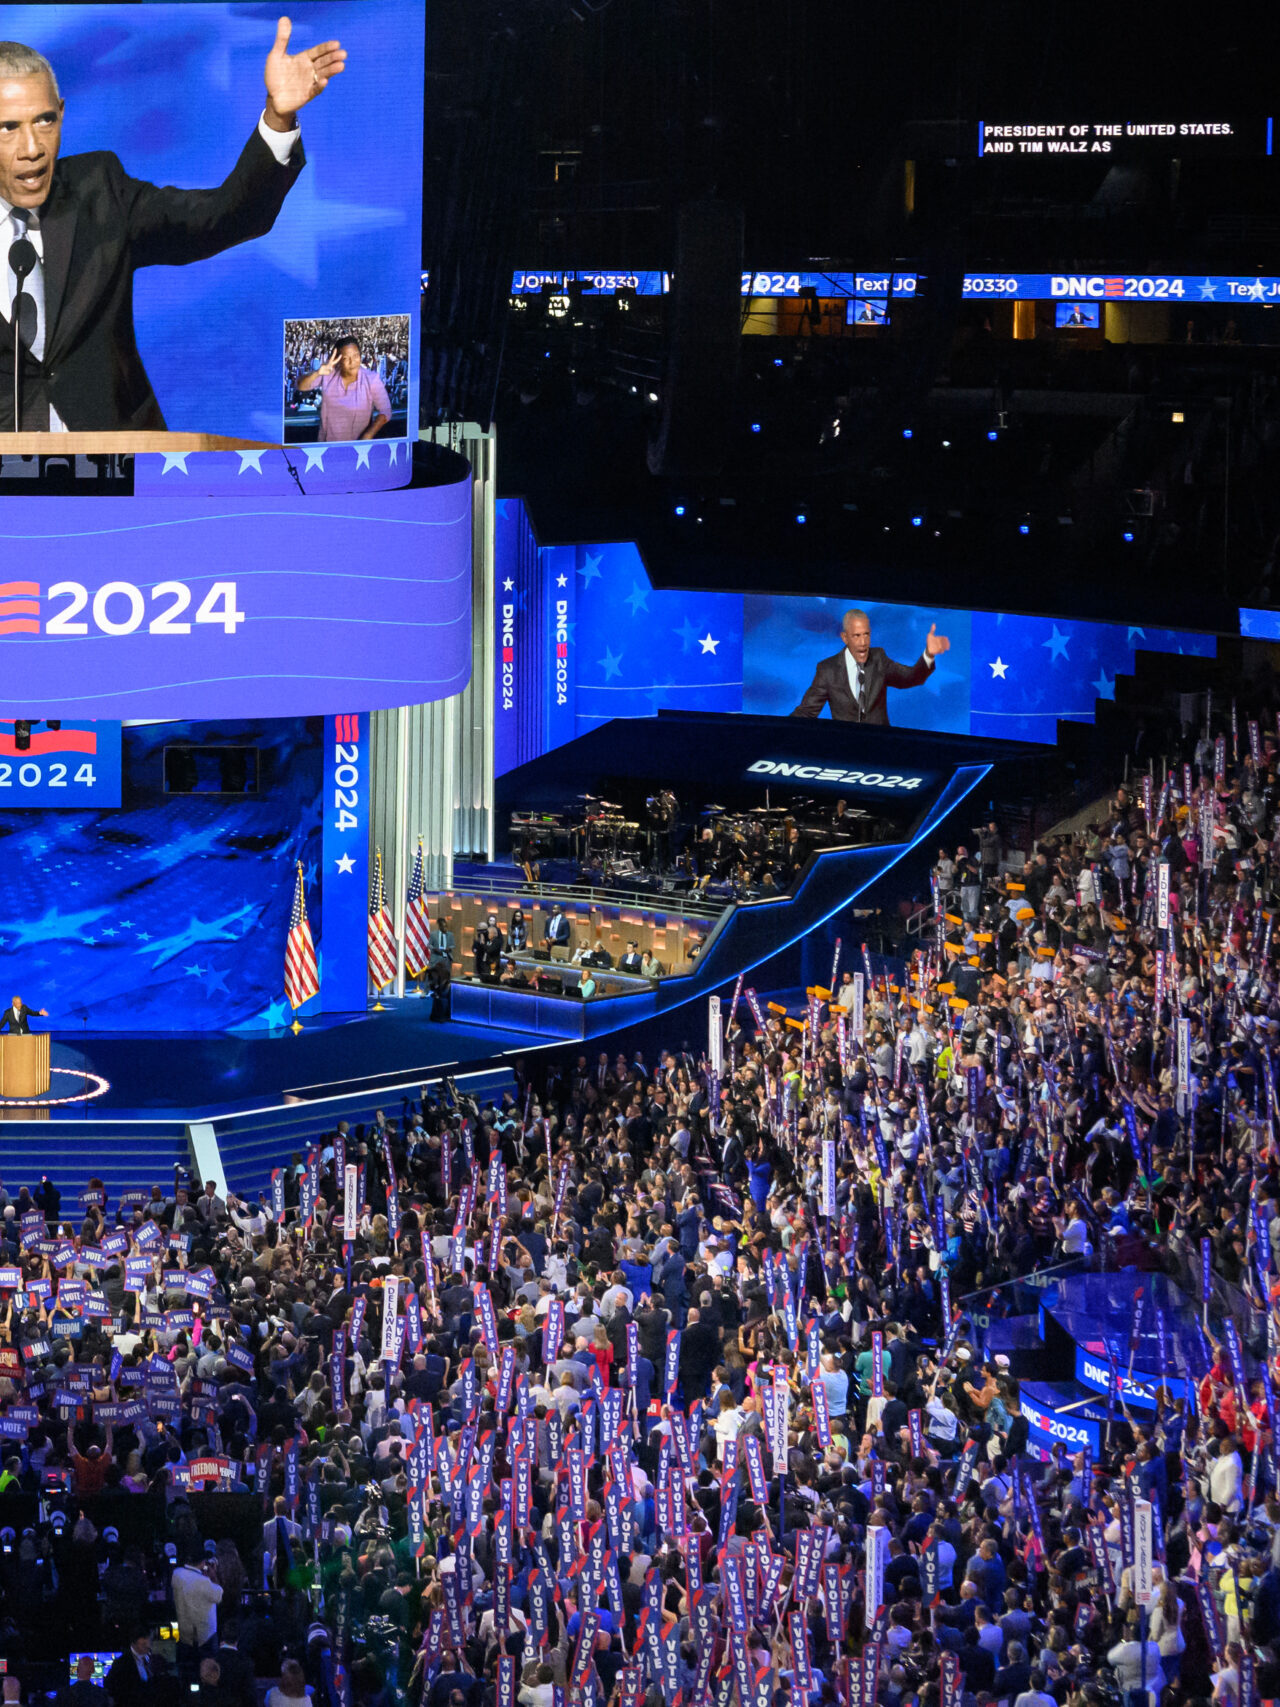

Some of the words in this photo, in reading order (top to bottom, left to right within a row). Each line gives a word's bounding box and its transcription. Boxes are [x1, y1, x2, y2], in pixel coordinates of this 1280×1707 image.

[985, 126, 1065, 137] PRESIDENT
[1070, 125, 1089, 136] OF
[1095, 124, 1122, 136] THE
[1127, 124, 1176, 135] UNITED
[1180, 123, 1234, 135] STATES.
[984, 141, 1014, 153] AND
[1019, 141, 1043, 153] TIM
[1048, 141, 1088, 152] WALZ
[1092, 141, 1111, 152] AS
[741, 275, 801, 292] 2024
[855, 278, 889, 290] Text
[963, 278, 1018, 293] 30330
[1051, 277, 1105, 296] DNC
[1124, 278, 1185, 297] 2024
[1227, 282, 1264, 296] Text
[46, 581, 245, 635] 2024
[556, 600, 567, 642] DNC
[502, 603, 513, 647] DNC
[502, 663, 513, 710] 2024
[556, 658, 567, 705] 2024
[335, 744, 358, 832] 2024
[747, 760, 821, 782] DNC
[839, 769, 922, 790] 2024
[1159, 871, 1168, 922] IDAHO
[487, 1160, 500, 1192] VOTE
[82, 1192, 98, 1201] VOTE
[389, 1196, 397, 1228] VOTE
[137, 1226, 158, 1241] VOTE
[170, 1239, 188, 1249] PEOPLE
[56, 1249, 73, 1263] VOTE
[84, 1252, 101, 1261] VOTE
[130, 1260, 147, 1270] VOTE
[0, 1272, 16, 1281] VOTE
[168, 1274, 185, 1283] VOTE
[191, 1280, 208, 1292] VOTE
[15, 1292, 38, 1308] USA
[54, 1322, 80, 1334] FREEDOM
[173, 1313, 190, 1323] VOTE
[385, 1288, 395, 1348] DELAWARE
[409, 1306, 419, 1342] VOTE
[547, 1312, 558, 1352] VOTE
[232, 1349, 250, 1365] VOTE
[667, 1342, 678, 1381] VOTE
[125, 1372, 142, 1380] VOTE
[99, 1408, 118, 1417] VOTE
[1021, 1401, 1041, 1428] DNC
[1049, 1421, 1089, 1445] 2024
[584, 1415, 593, 1455] VOTE
[191, 1462, 218, 1477] FREEDOM
[749, 1447, 763, 1489] VOTE
[573, 1464, 582, 1505] VOTE
[411, 1500, 421, 1543] VOTE
[926, 1552, 935, 1594] VOTE
[533, 1585, 544, 1630] VOTE
[729, 1571, 742, 1615] VOTE
[827, 1579, 838, 1622] VOTE
[793, 1627, 805, 1672] VOTE
